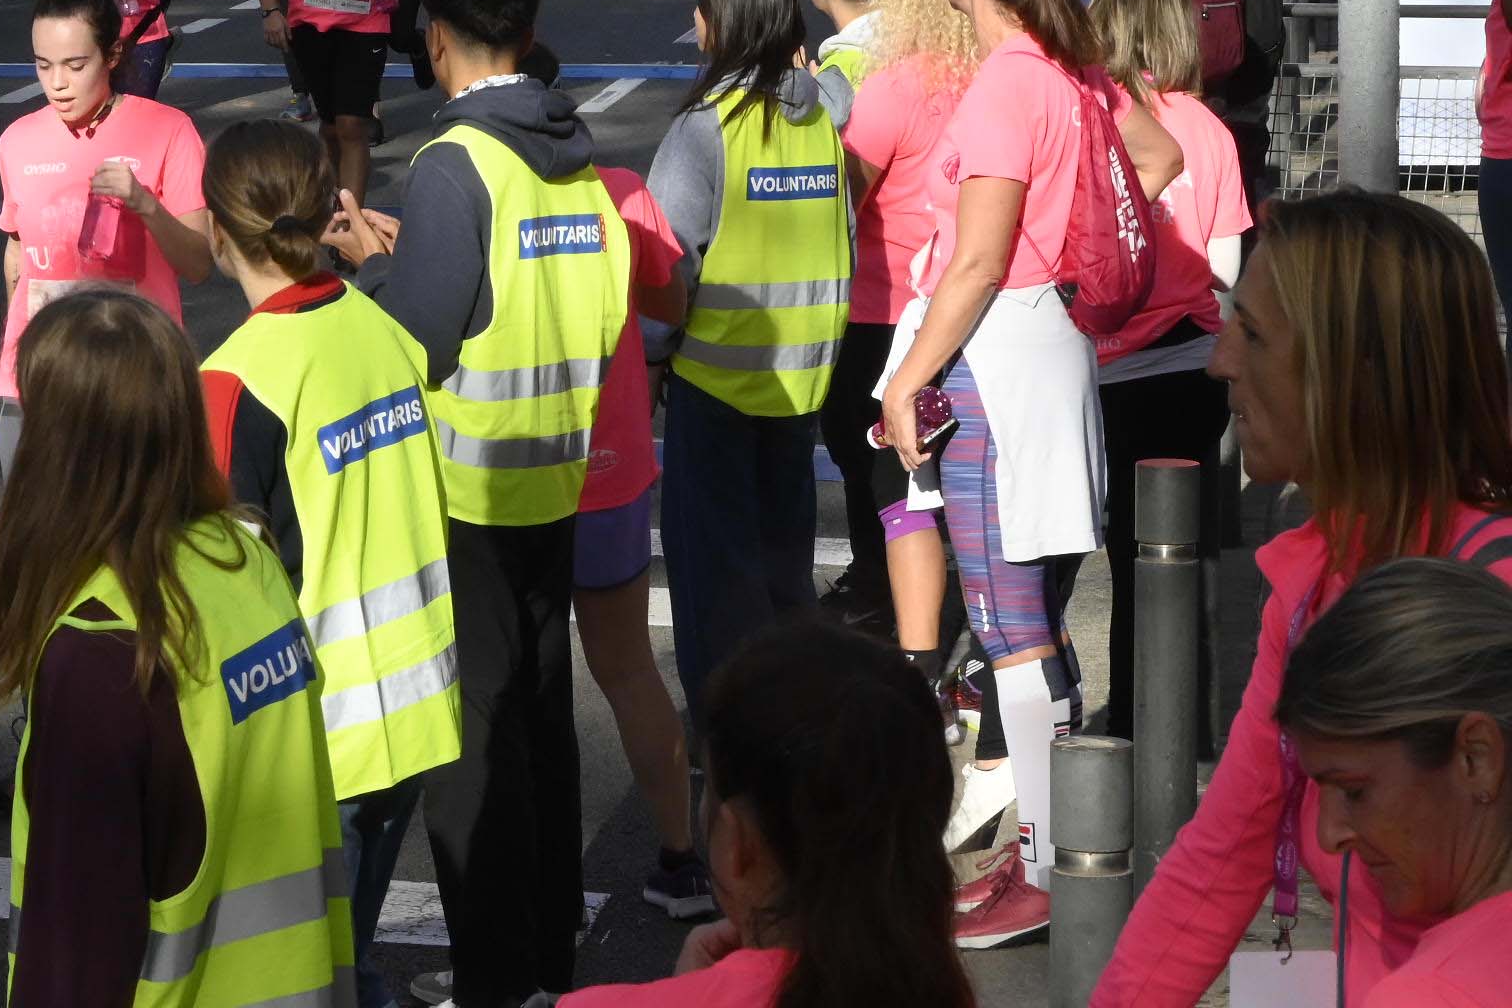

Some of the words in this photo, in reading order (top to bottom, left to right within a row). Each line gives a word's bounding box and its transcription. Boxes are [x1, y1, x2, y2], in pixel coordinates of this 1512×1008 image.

[24, 162, 66, 175] OYSHO
[750, 174, 837, 193] VOLUNTARIS
[323, 399, 423, 459] VOLUNTARIS
